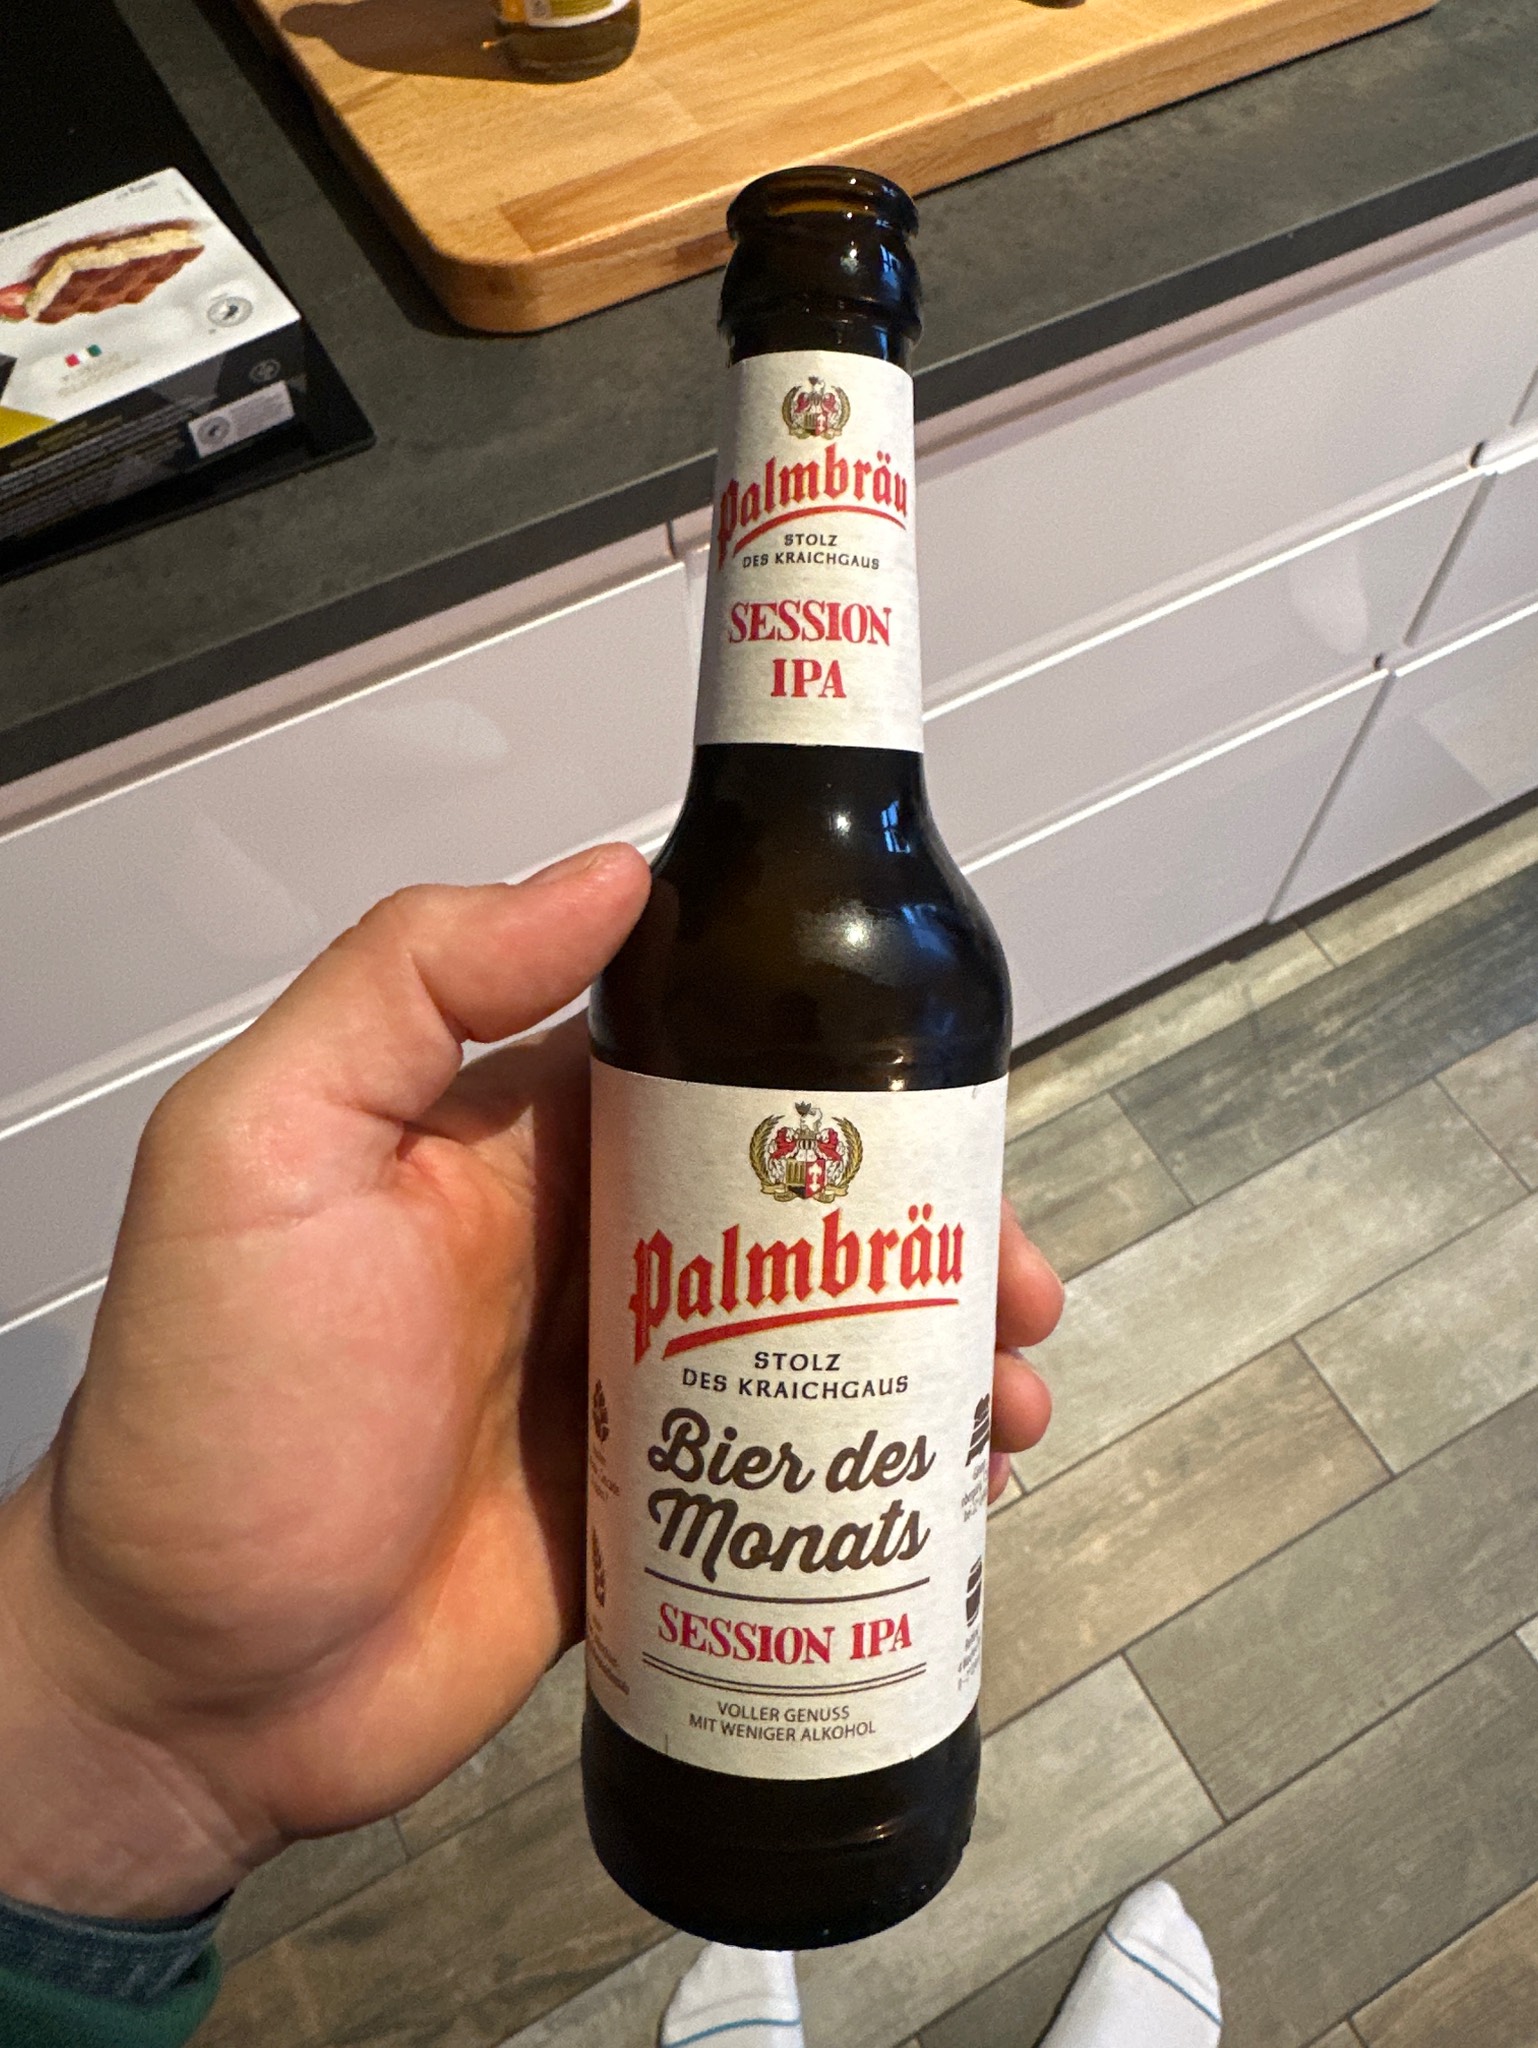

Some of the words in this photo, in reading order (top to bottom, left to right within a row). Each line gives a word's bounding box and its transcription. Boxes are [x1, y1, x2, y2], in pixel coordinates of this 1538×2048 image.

[717, 443, 907, 571] Palmbräu
[784, 533, 838, 547] STOLZ
[743, 553, 769, 569] DES
[775, 551, 880, 570] KRAICHGAUS
[728, 599, 892, 647] SESSION
[771, 658, 847, 698] IPA
[628, 1203, 965, 1365] Palmbräu
[754, 1351, 841, 1372] STOLZ
[682, 1368, 727, 1392] DES
[738, 1375, 909, 1399] KRAICHGAUS
[648, 1407, 815, 1493] Bier
[826, 1430, 936, 1492] des
[648, 1488, 931, 1583] Monats
[658, 1602, 836, 1665] SESSION
[850, 1613, 912, 1660] IPA
[689, 1713, 716, 1732] MIT
[720, 1720, 796, 1741] WENIGER
[800, 1720, 876, 1742] ALKOHOL
[717, 1701, 779, 1722] VOLLER
[784, 1705, 850, 1723] GENUSS
